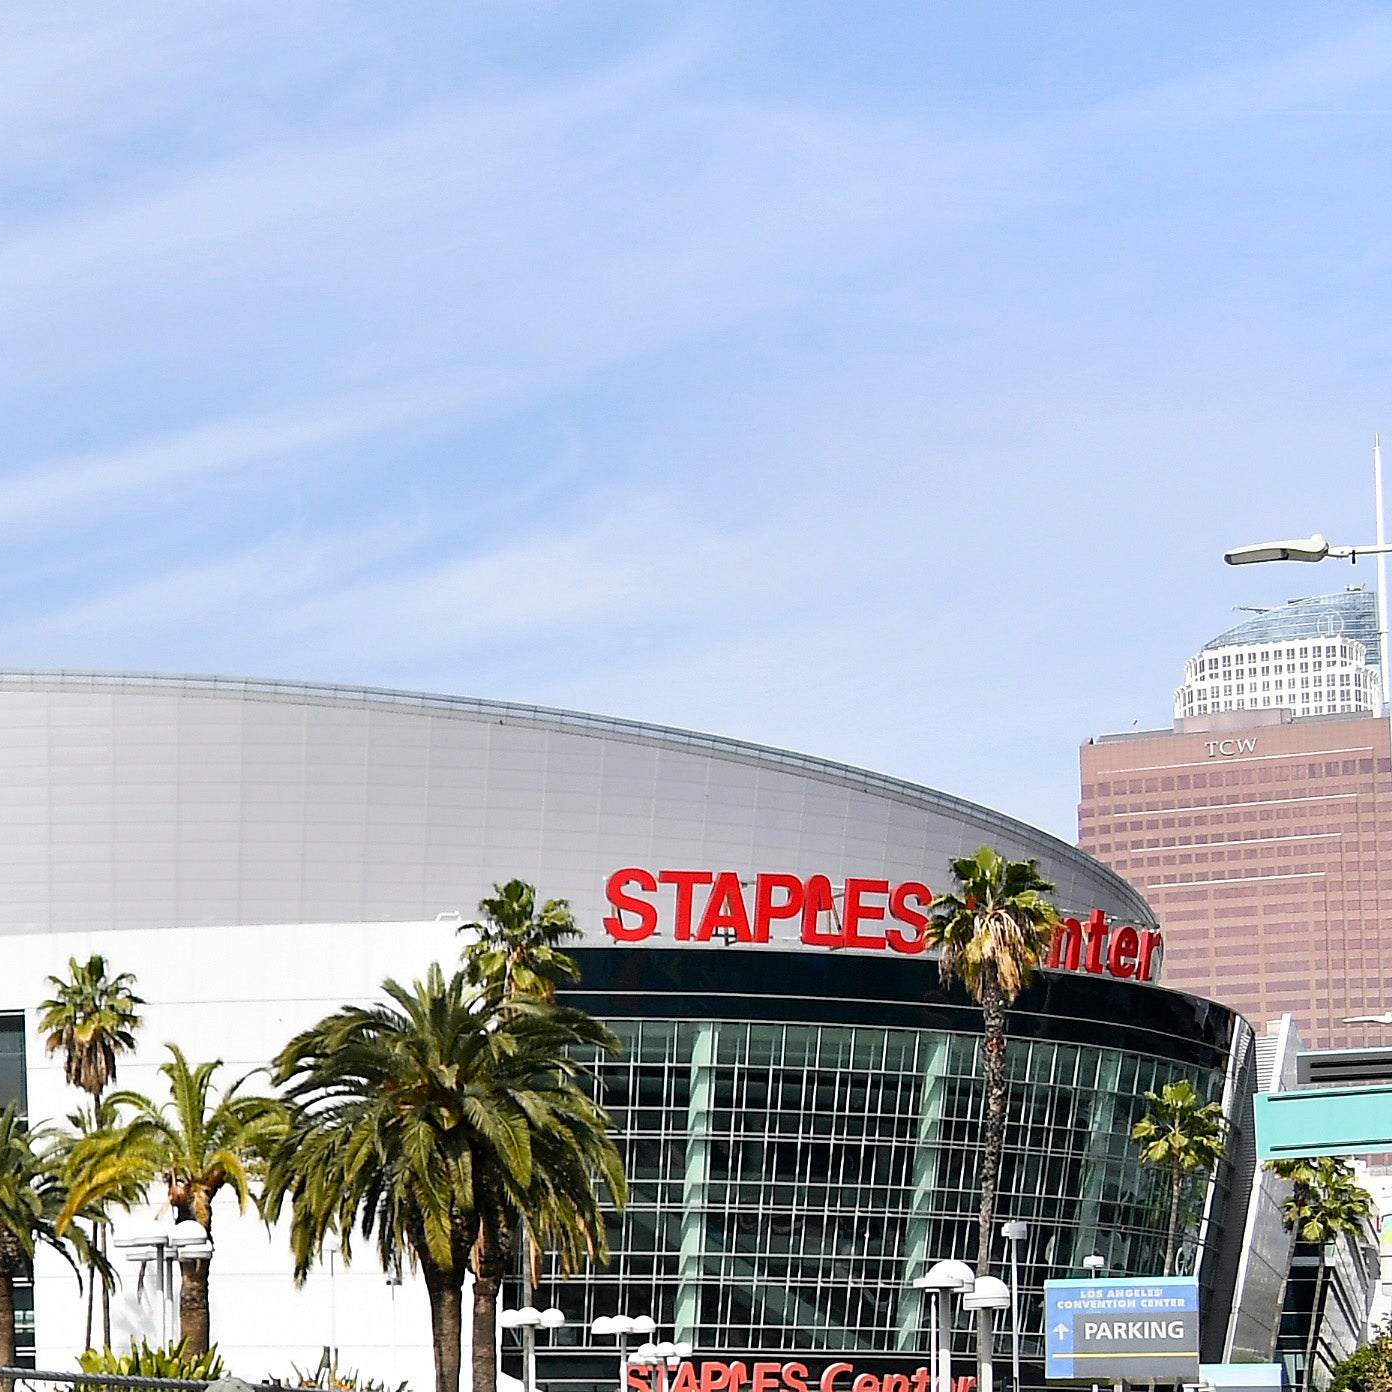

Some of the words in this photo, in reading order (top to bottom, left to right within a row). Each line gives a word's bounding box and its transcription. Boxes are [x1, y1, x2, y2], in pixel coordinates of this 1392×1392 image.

[1205, 738, 1257, 757] TCW
[603, 867, 934, 955] STAPLES
[1044, 908, 1162, 981] nter
[1080, 1289, 1103, 1299] LOS
[1056, 1299, 1136, 1310] CONVENTION
[1140, 1298, 1185, 1308] CENTER
[1084, 1320, 1184, 1341] PARKING
